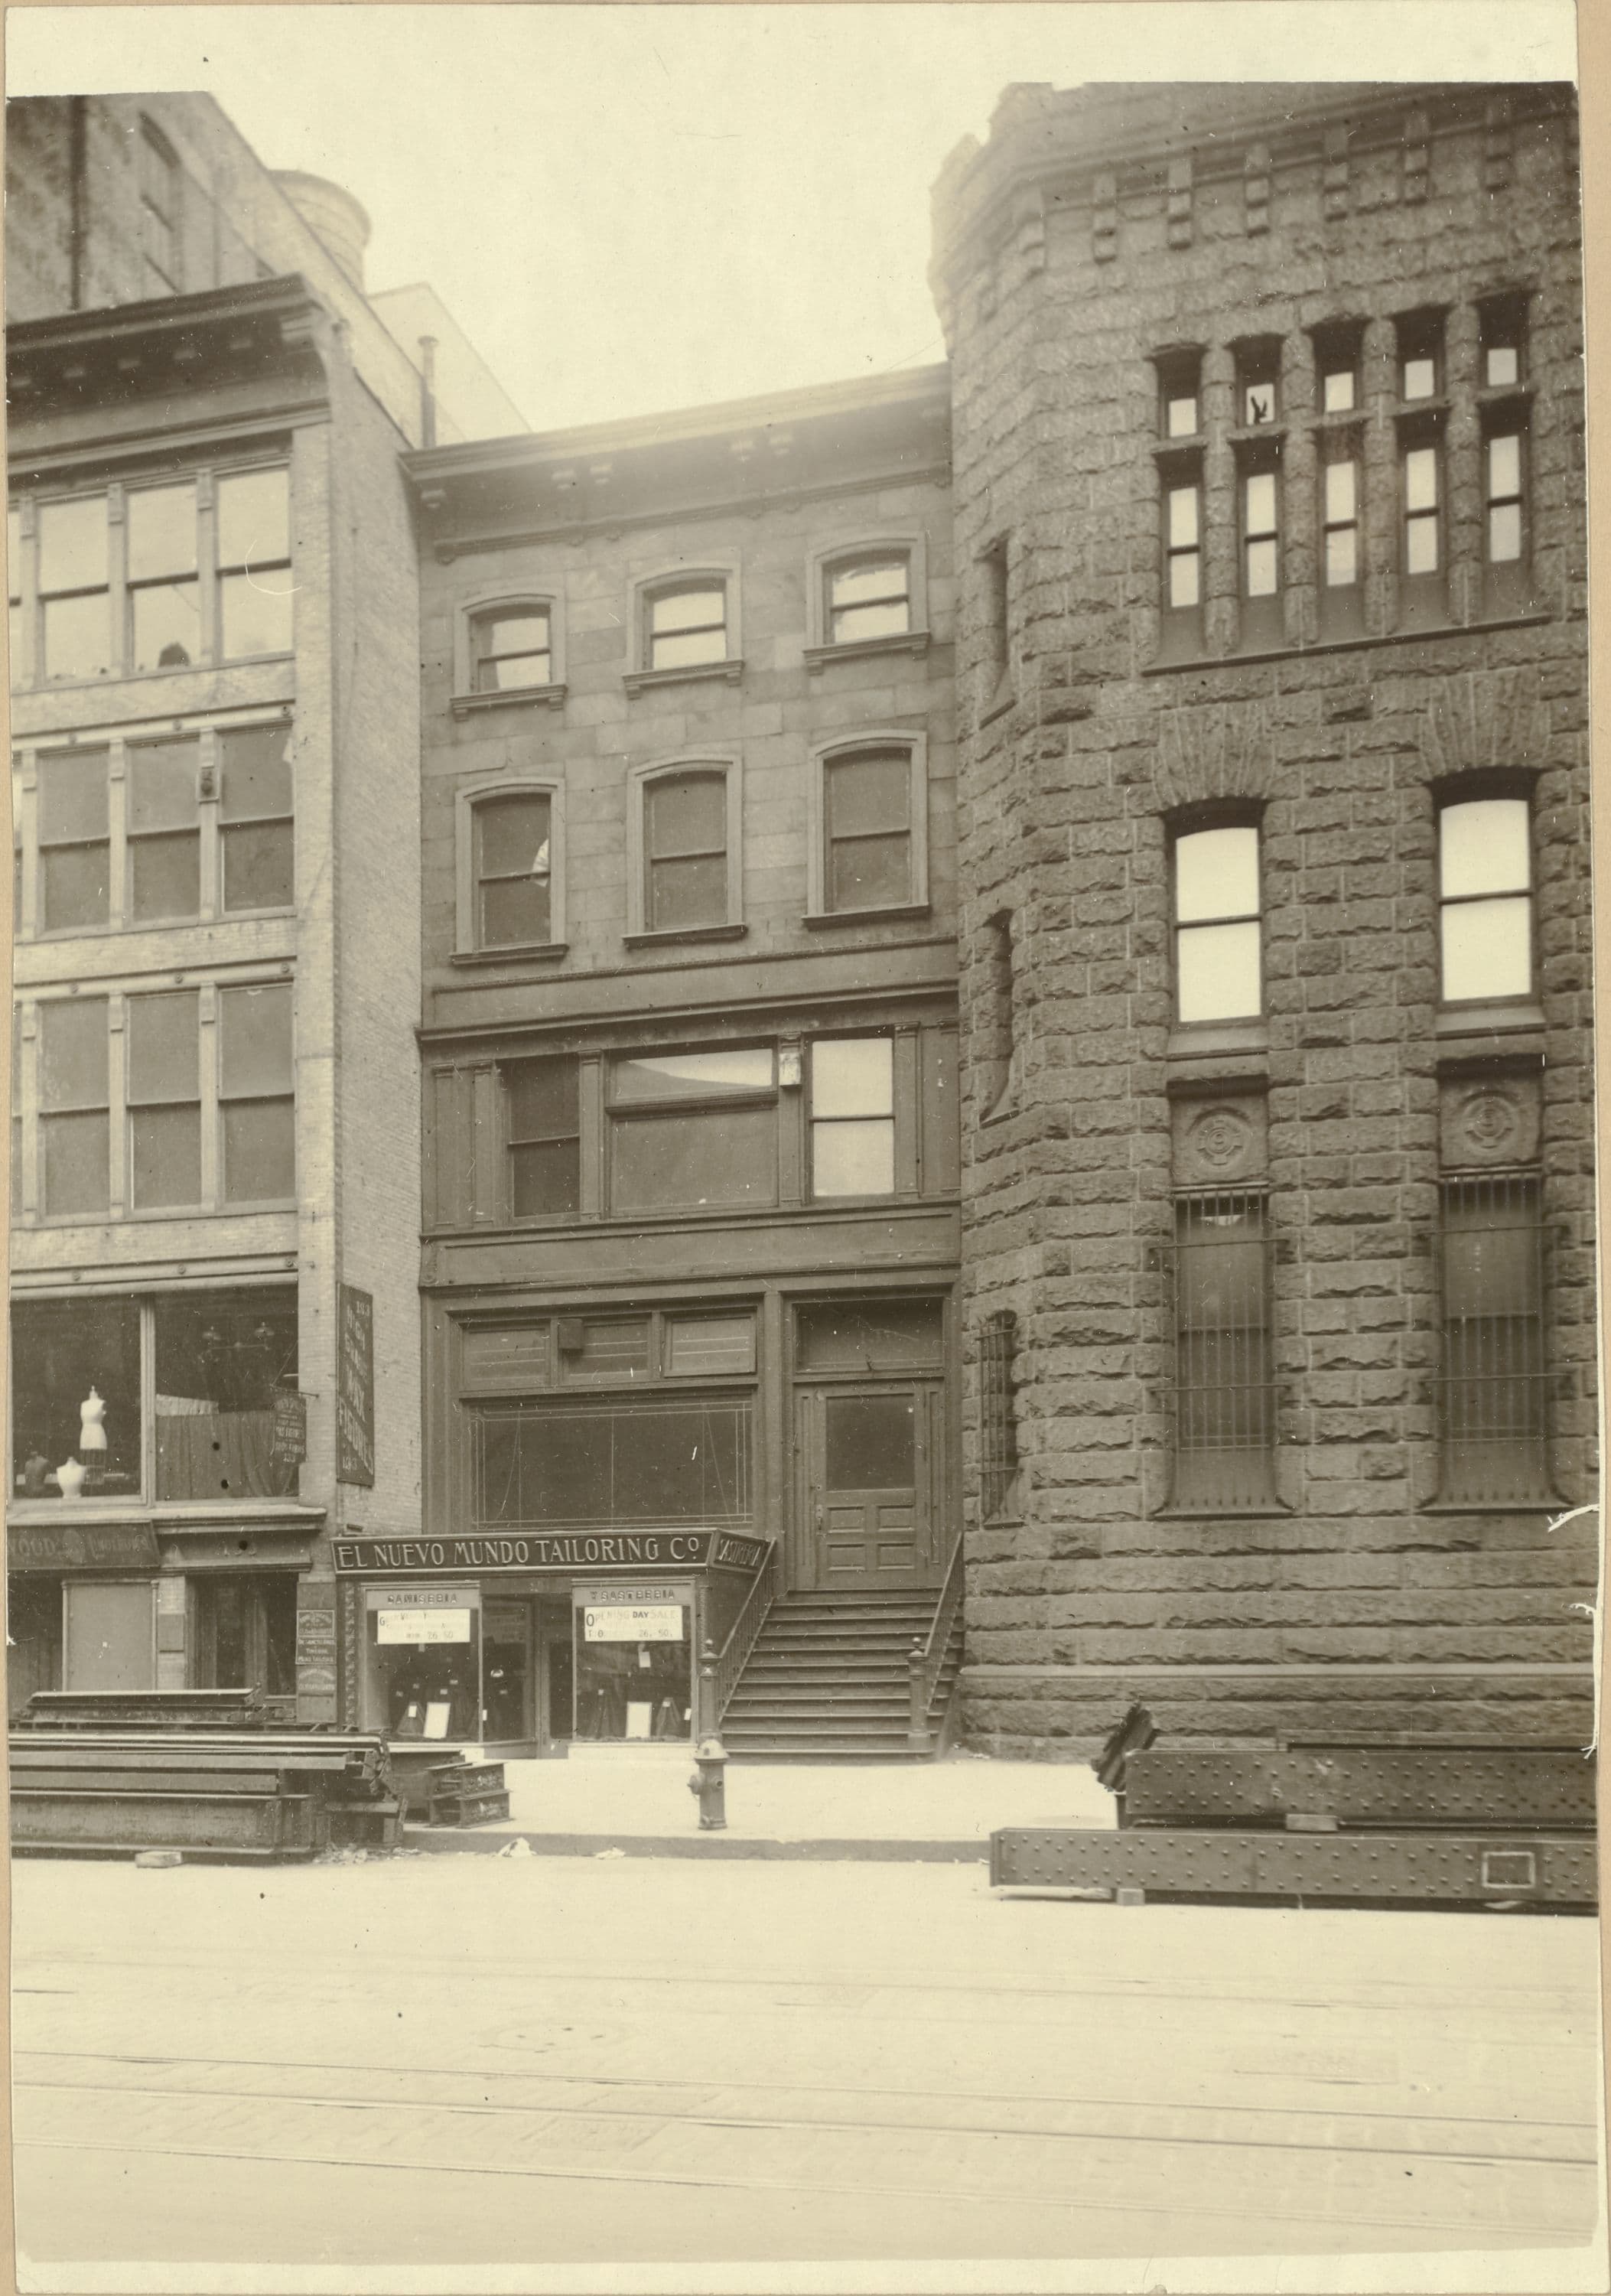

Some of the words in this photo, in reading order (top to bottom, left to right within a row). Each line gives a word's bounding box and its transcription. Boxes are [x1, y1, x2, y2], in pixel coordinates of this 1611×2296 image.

[338, 1545, 368, 1568] EL
[373, 1542, 445, 1567] NUEVO
[454, 1541, 529, 1565] MUNDO
[535, 1538, 661, 1563] TAILORING
[633, 1610, 649, 1620] DAY
